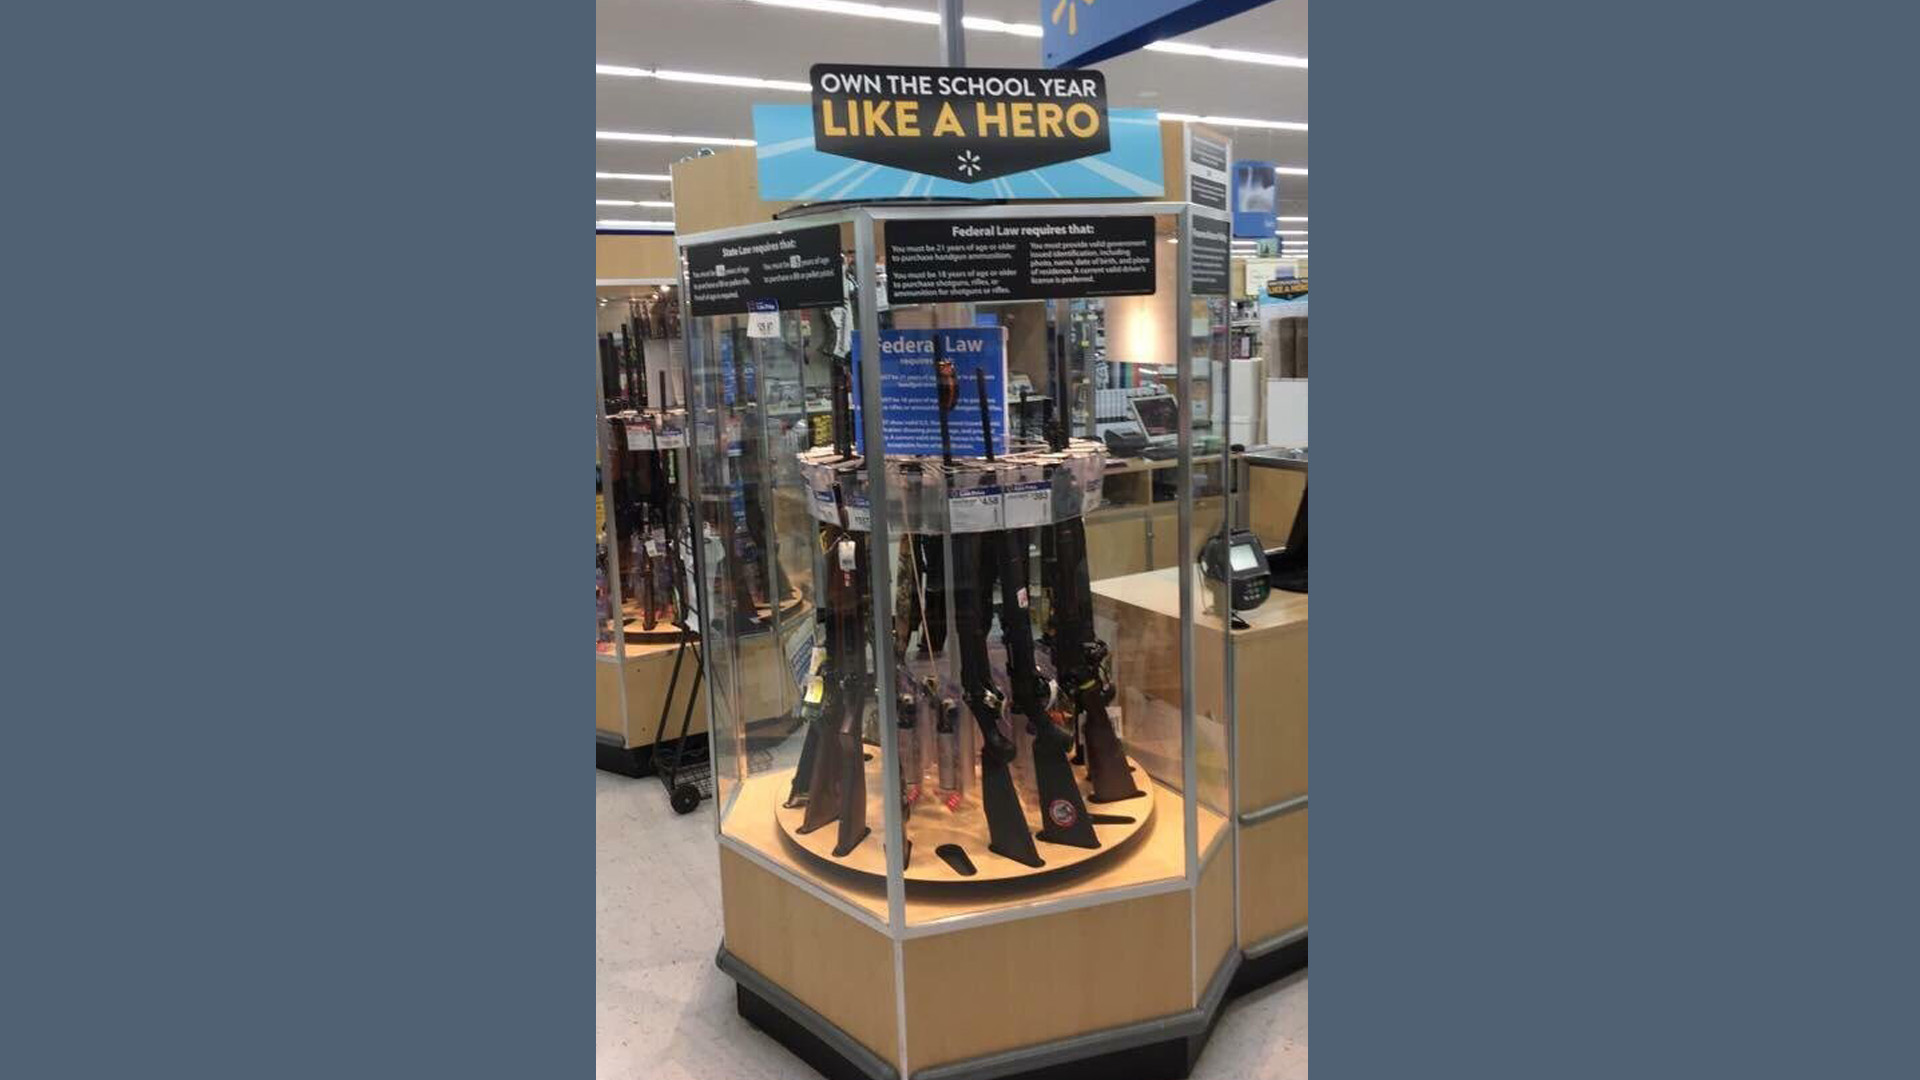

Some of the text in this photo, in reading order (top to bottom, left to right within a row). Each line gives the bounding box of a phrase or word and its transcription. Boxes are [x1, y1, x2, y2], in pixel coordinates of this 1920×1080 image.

[820, 73, 1097, 98] OWN THE SCHOOL YEAR
[821, 98, 1100, 139] LIKE A HERO
[952, 222, 1095, 238] Federal Law requires that:
[722, 246, 738, 258] State
[738, 245, 752, 256] Law
[752, 241, 779, 255] requires
[892, 244, 905, 254] You
[907, 244, 924, 252] must
[925, 243, 935, 252] be
[936, 243, 945, 252] 21
[947, 244, 965, 254] years
[966, 242, 974, 251] of
[975, 243, 988, 253] age
[998, 241, 1016, 250] older
[1029, 239, 1147, 250] You must provide valid government
[892, 254, 900, 262] to
[901, 253, 934, 262] purchase
[935, 252, 968, 262] handgun
[1119, 257, 1132, 265] and
[1132, 256, 1150, 266] place
[893, 271, 907, 280] You
[908, 270, 925, 279] must
[926, 269, 936, 278] be
[948, 270, 966, 280] years
[967, 269, 975, 278] of
[976, 270, 989, 279] age
[999, 267, 1017, 277] older
[1105, 265, 1121, 274] valid
[893, 280, 901, 289] to
[902, 280, 935, 290] purchase
[894, 288, 938, 298] ammunition
[938, 287, 949, 296] for
[949, 286, 982, 297] shotguns
[877, 336, 984, 353] edera Law
[900, 358, 934, 367] requires
